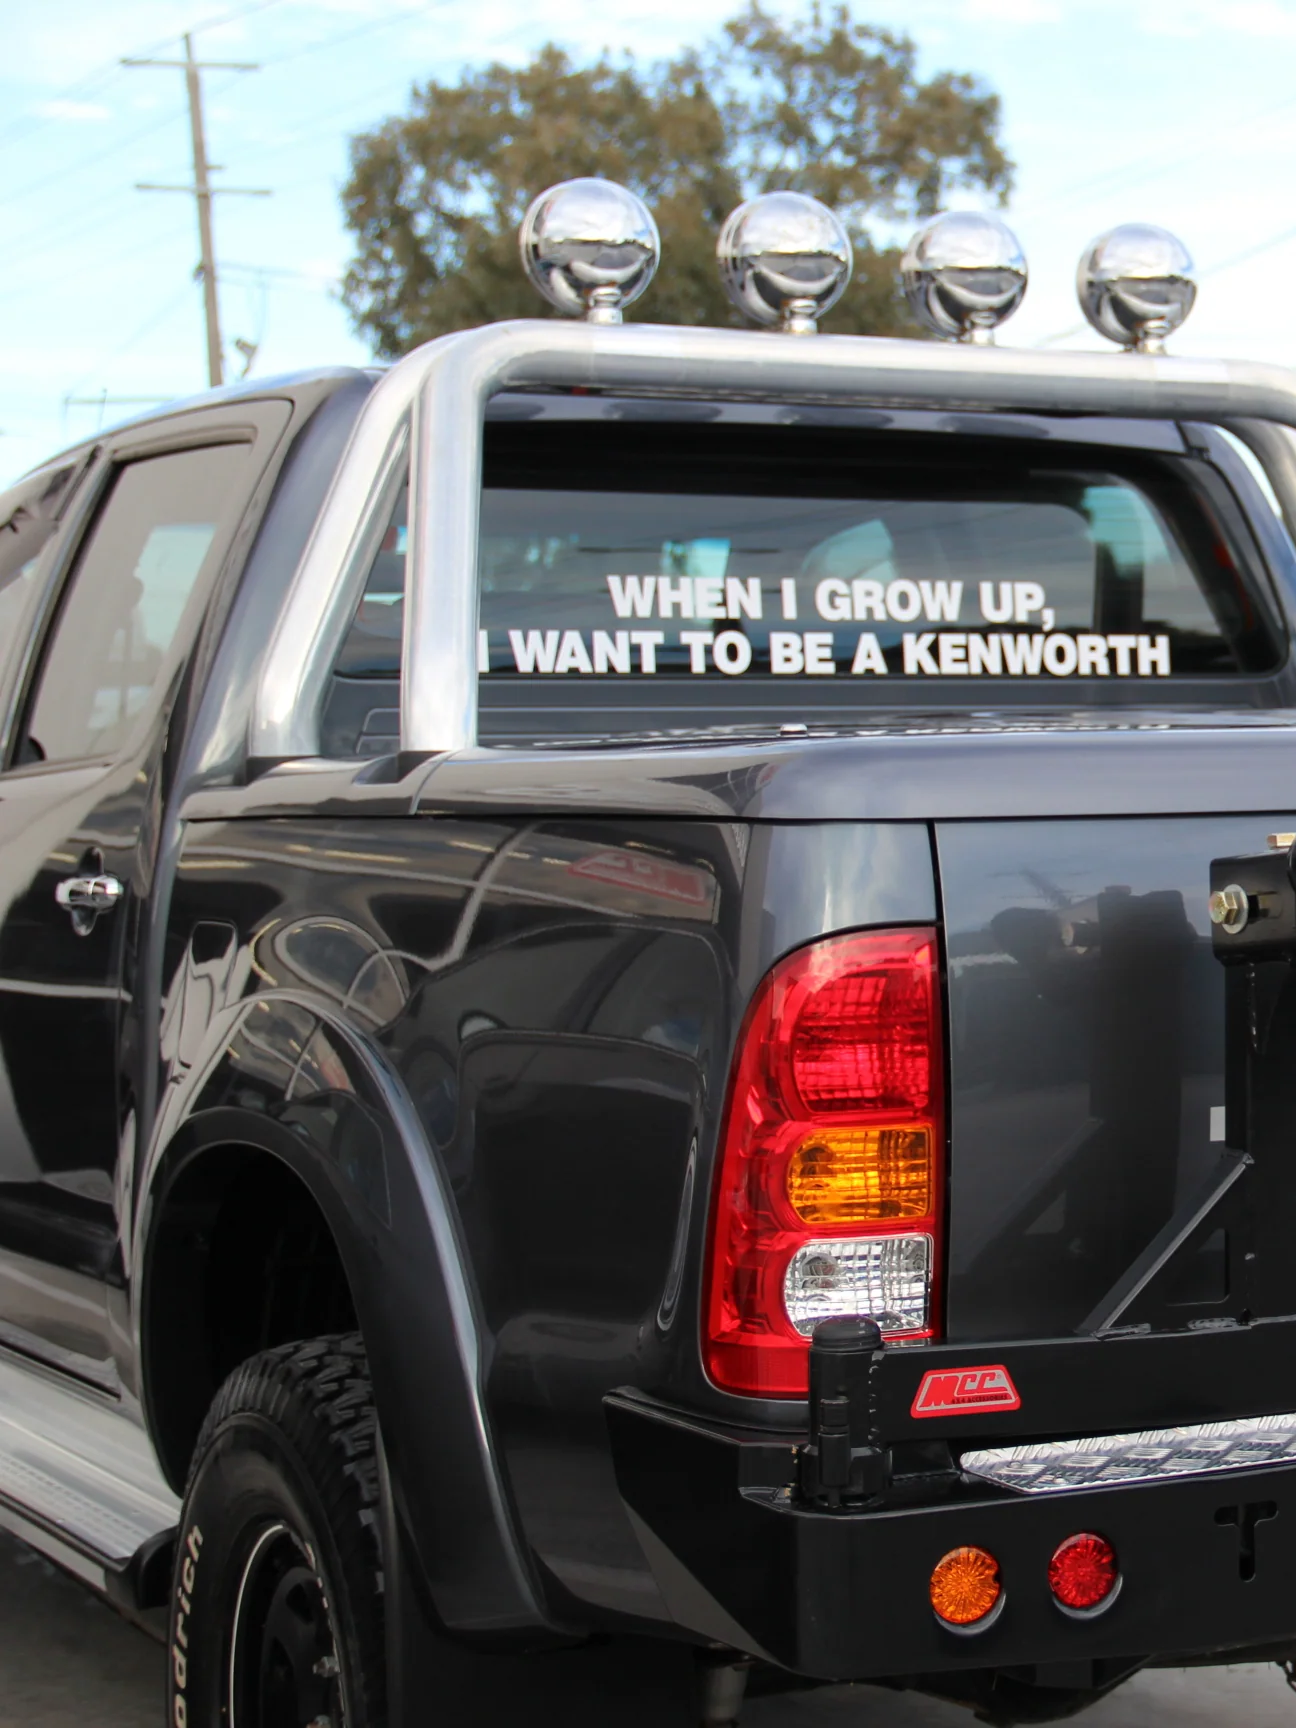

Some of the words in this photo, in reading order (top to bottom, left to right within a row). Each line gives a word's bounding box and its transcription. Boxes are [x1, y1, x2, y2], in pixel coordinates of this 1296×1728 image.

[607, 574, 761, 620] WHEN
[781, 577, 797, 619] I
[814, 579, 962, 622] GROW
[980, 581, 1054, 632] UP,
[478, 630, 490, 673] I
[508, 630, 664, 674] WANT
[680, 631, 752, 675] TO
[770, 632, 836, 675] BE
[852, 633, 889, 675] A
[902, 633, 1170, 676] KENWORTH
[919, 1372, 1008, 1408] MCC
